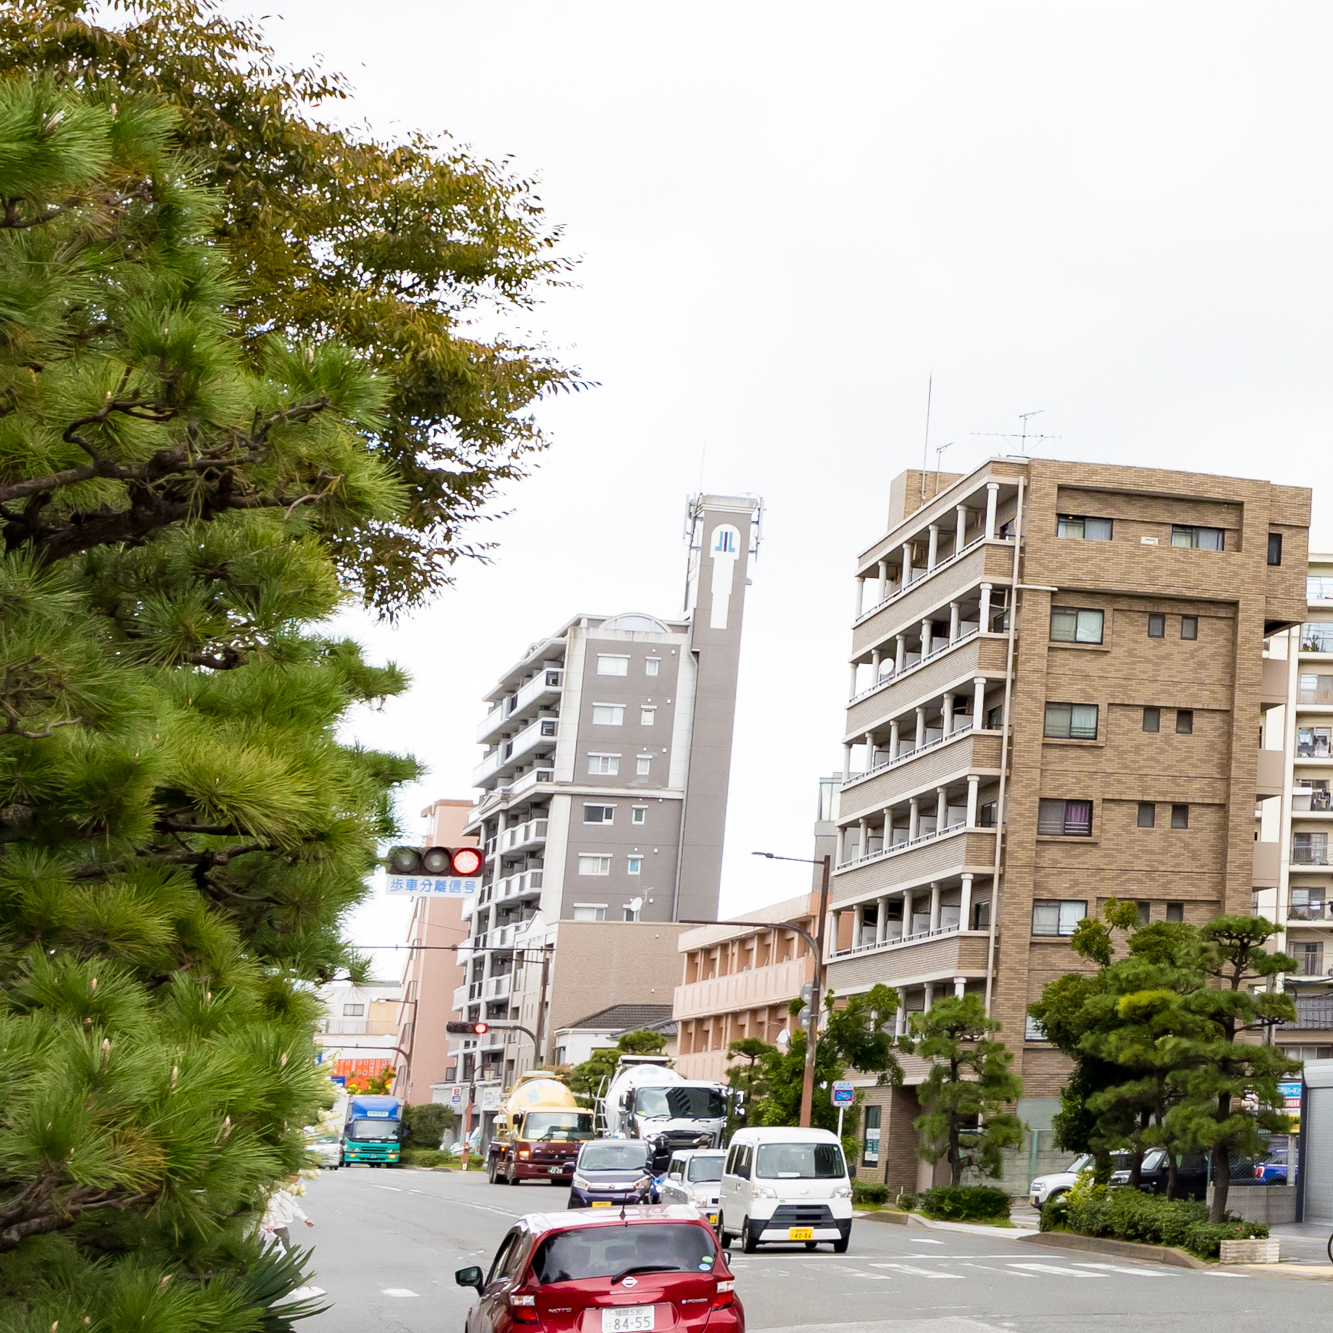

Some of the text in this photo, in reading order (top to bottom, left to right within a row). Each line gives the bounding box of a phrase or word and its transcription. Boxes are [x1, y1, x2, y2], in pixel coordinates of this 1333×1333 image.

[390, 878, 476, 894] 歩車分離信号
[630, 1308, 643, 1316] 530
[614, 1316, 650, 1330] 84-55
